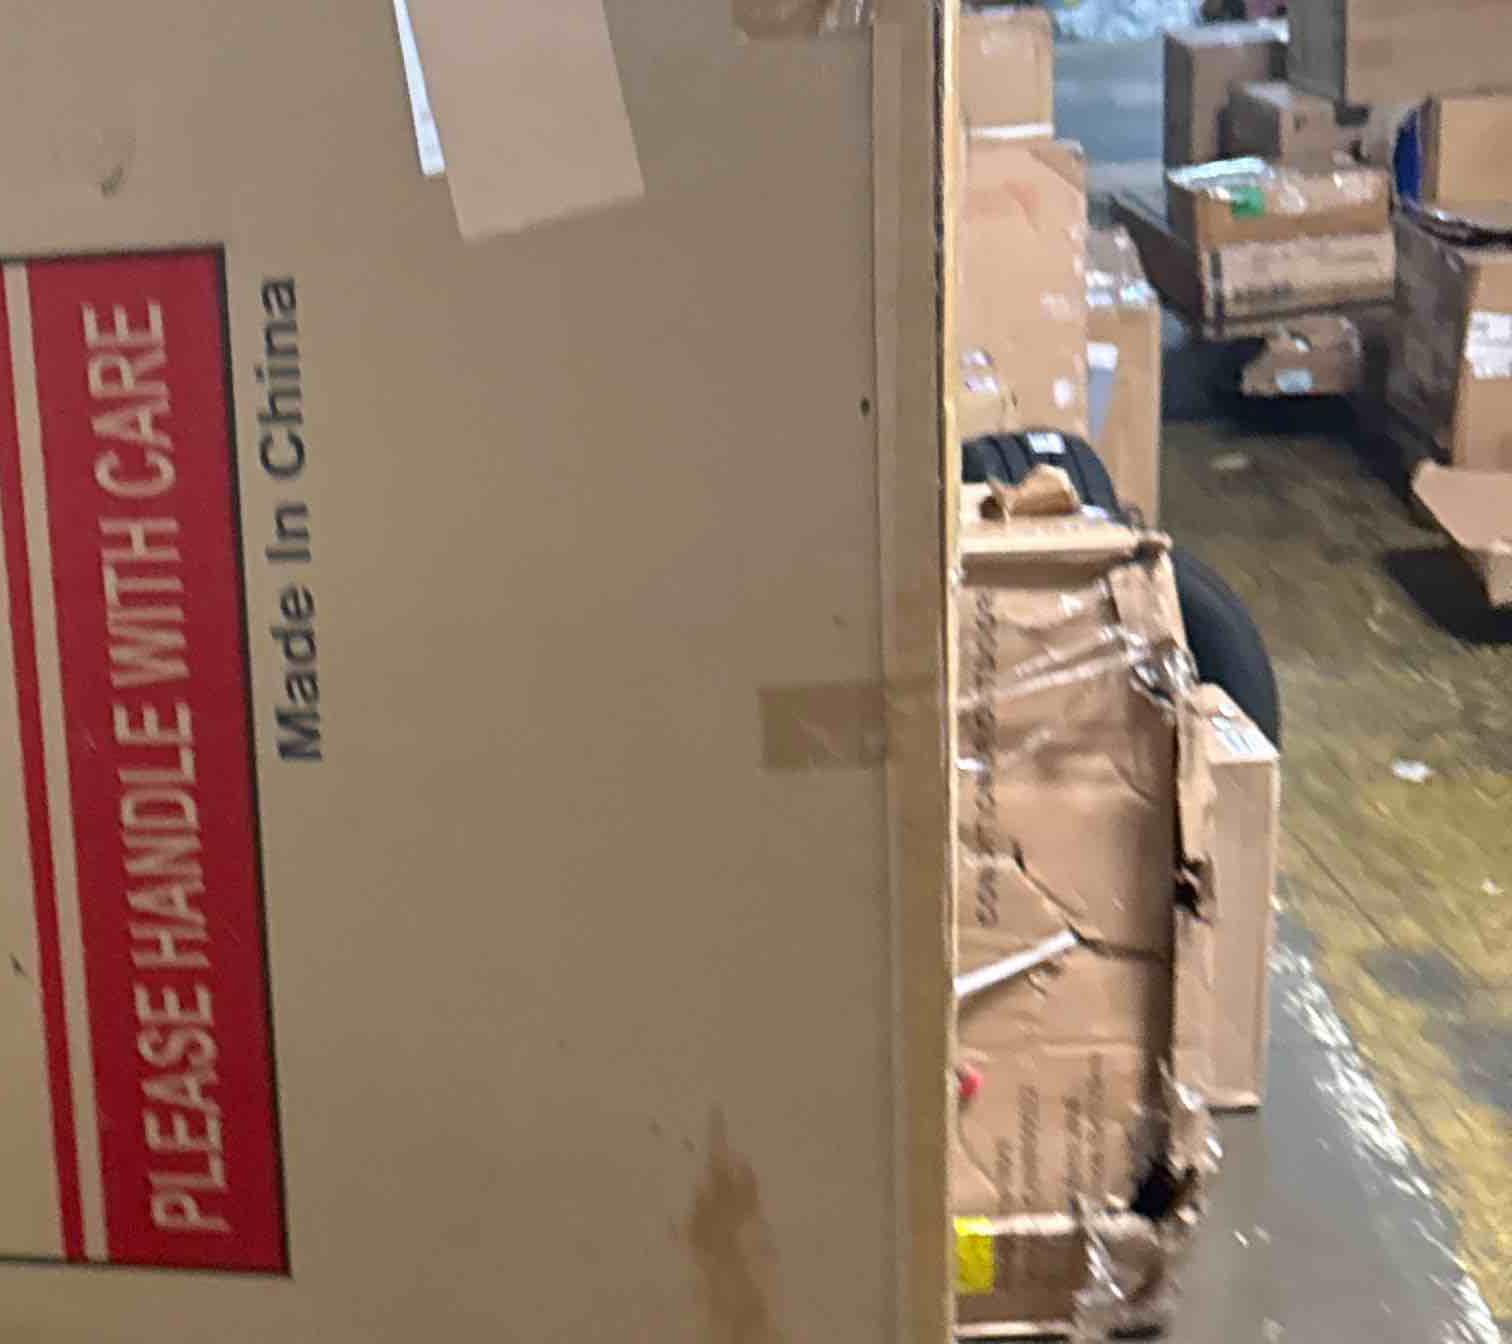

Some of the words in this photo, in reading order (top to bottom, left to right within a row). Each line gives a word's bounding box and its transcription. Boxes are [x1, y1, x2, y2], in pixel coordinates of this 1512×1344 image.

[82, 297, 178, 498] CARE
[254, 275, 308, 481] China
[97, 516, 187, 689] WITH
[265, 501, 314, 565] In
[267, 584, 323, 764] Made
[113, 697, 210, 967] HANDLE
[132, 983, 231, 1234] PLEASE
